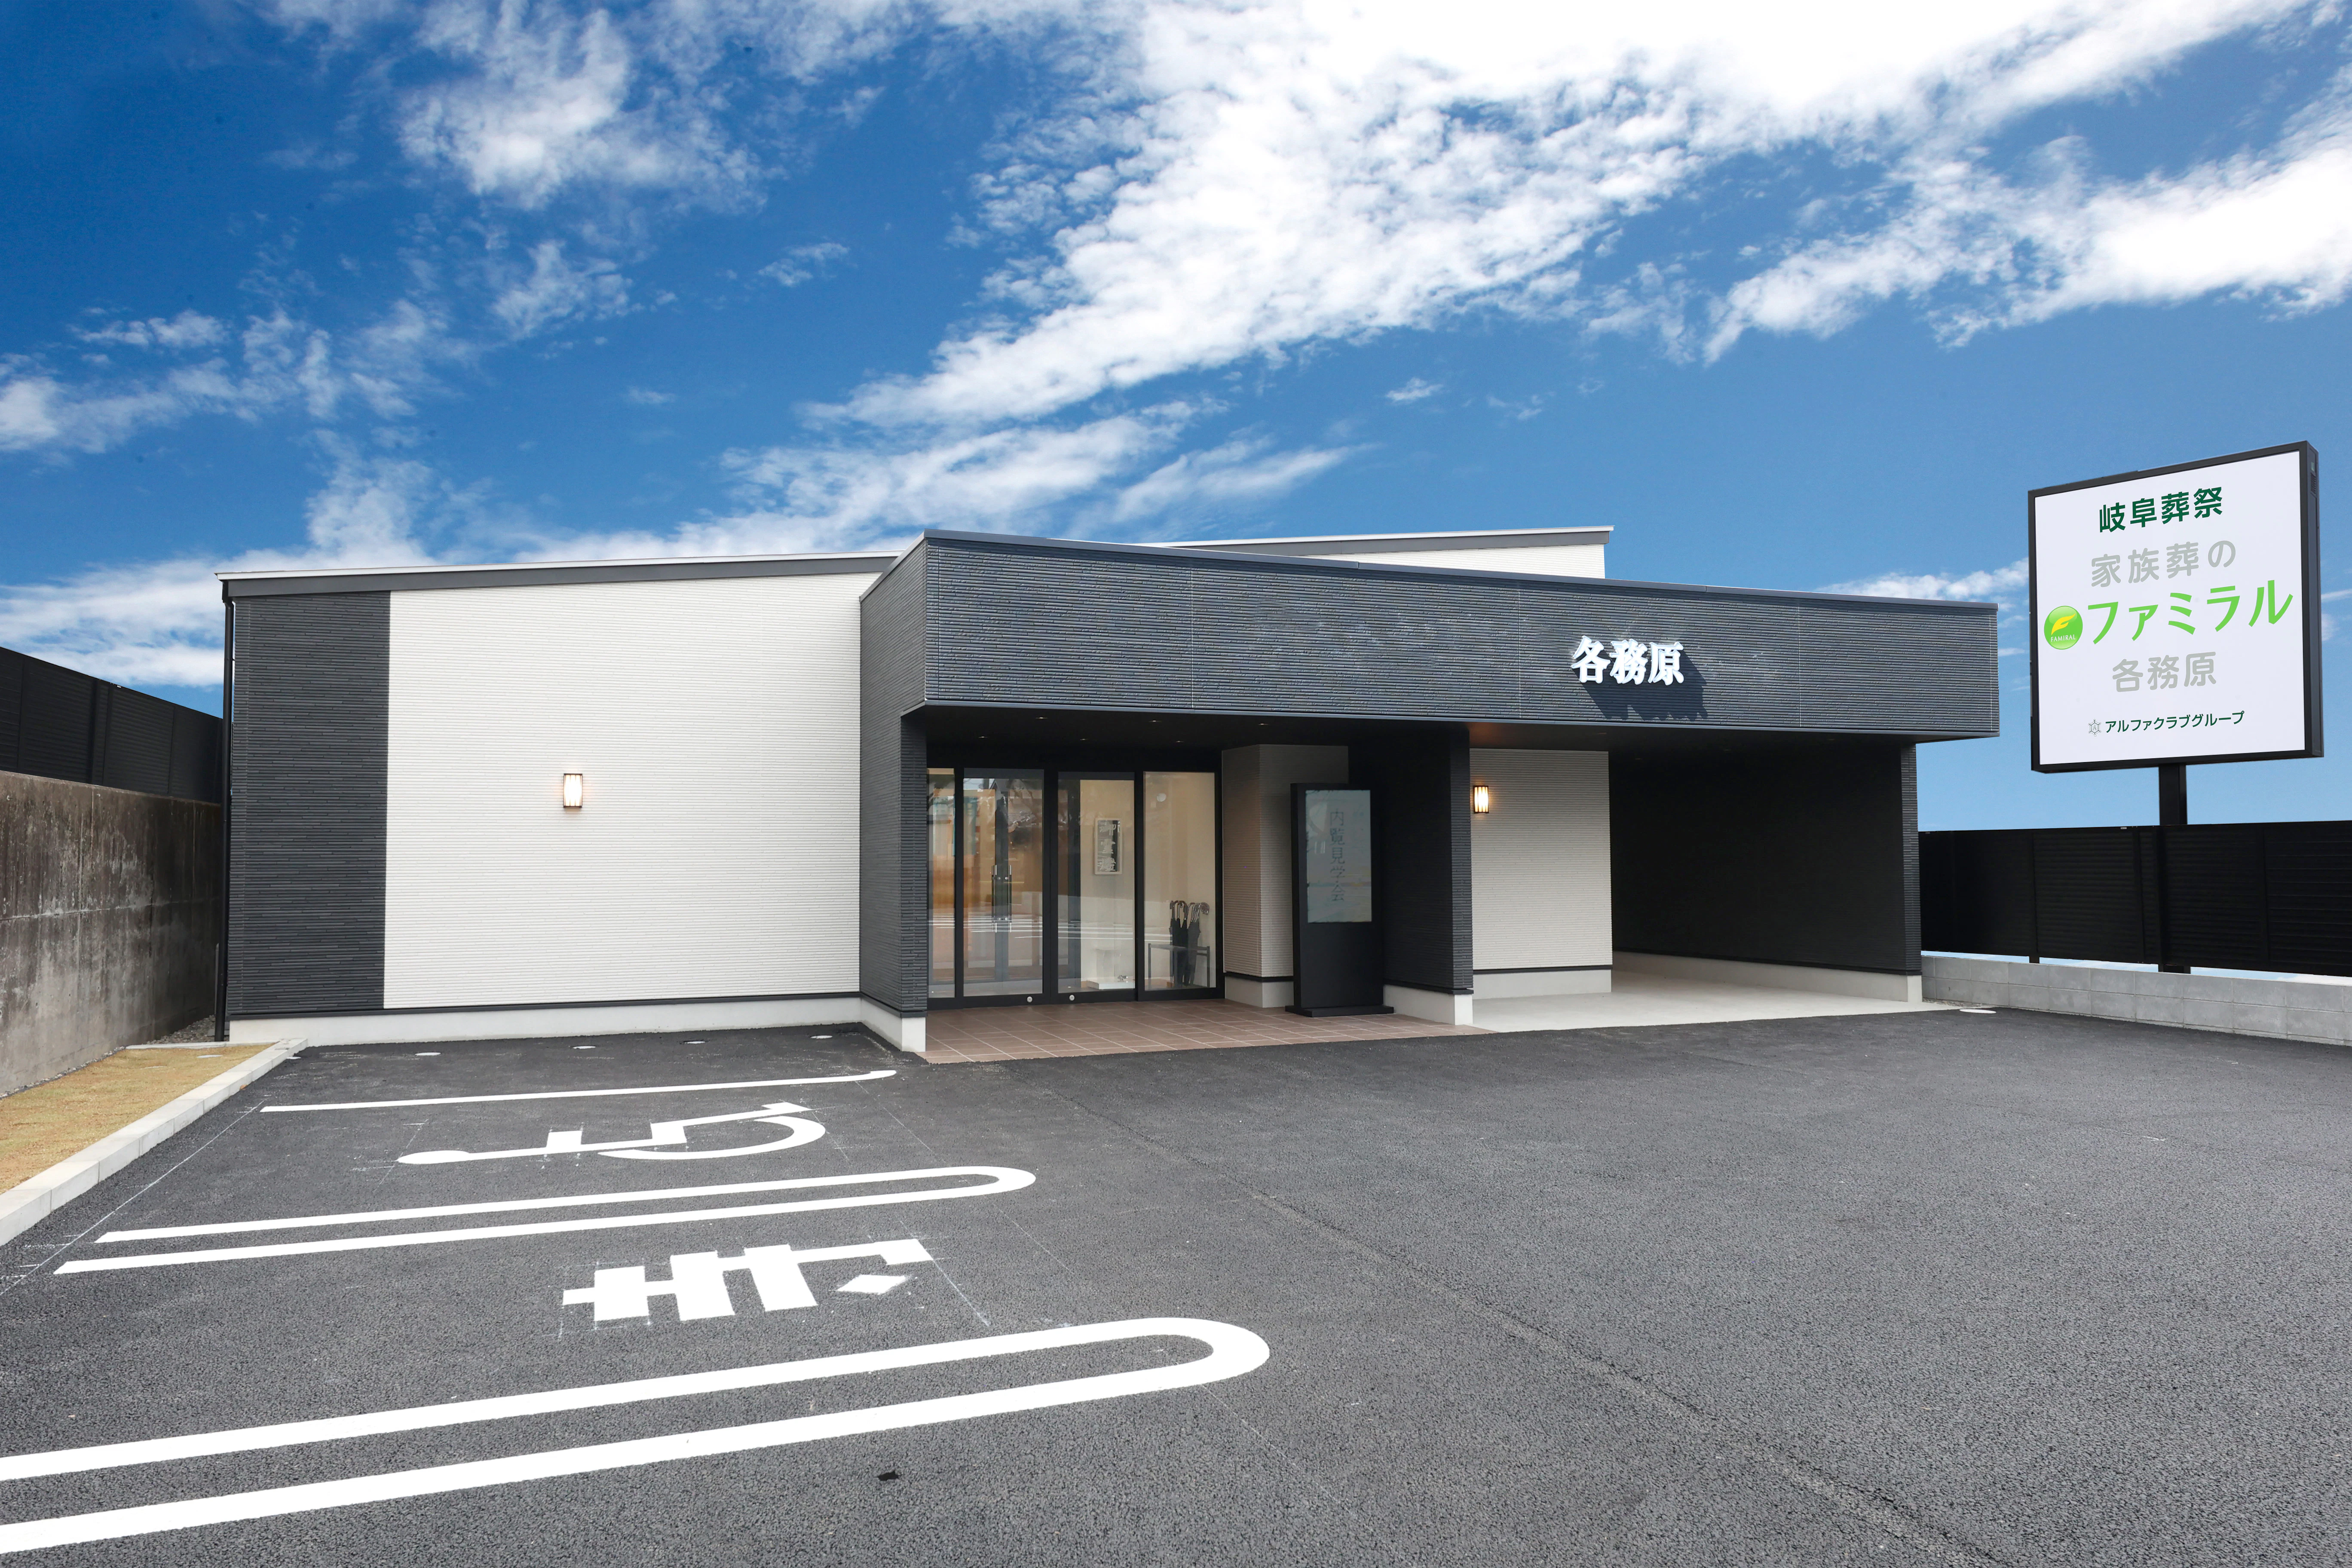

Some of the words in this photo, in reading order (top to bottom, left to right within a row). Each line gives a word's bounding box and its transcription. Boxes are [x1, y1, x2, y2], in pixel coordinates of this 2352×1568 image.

[2099, 487, 2223, 533] 岐阜葬祭
[2091, 540, 2236, 588] 家族葬の
[2088, 579, 2293, 644] ファミラル
[1570, 635, 1684, 686] 各務原
[2051, 634, 2076, 642] FAMIRAL
[2112, 652, 2217, 692] 各務原
[2105, 710, 2245, 733] アルファクラブグループ
[1329, 809, 1346, 902] 内覧見学会
